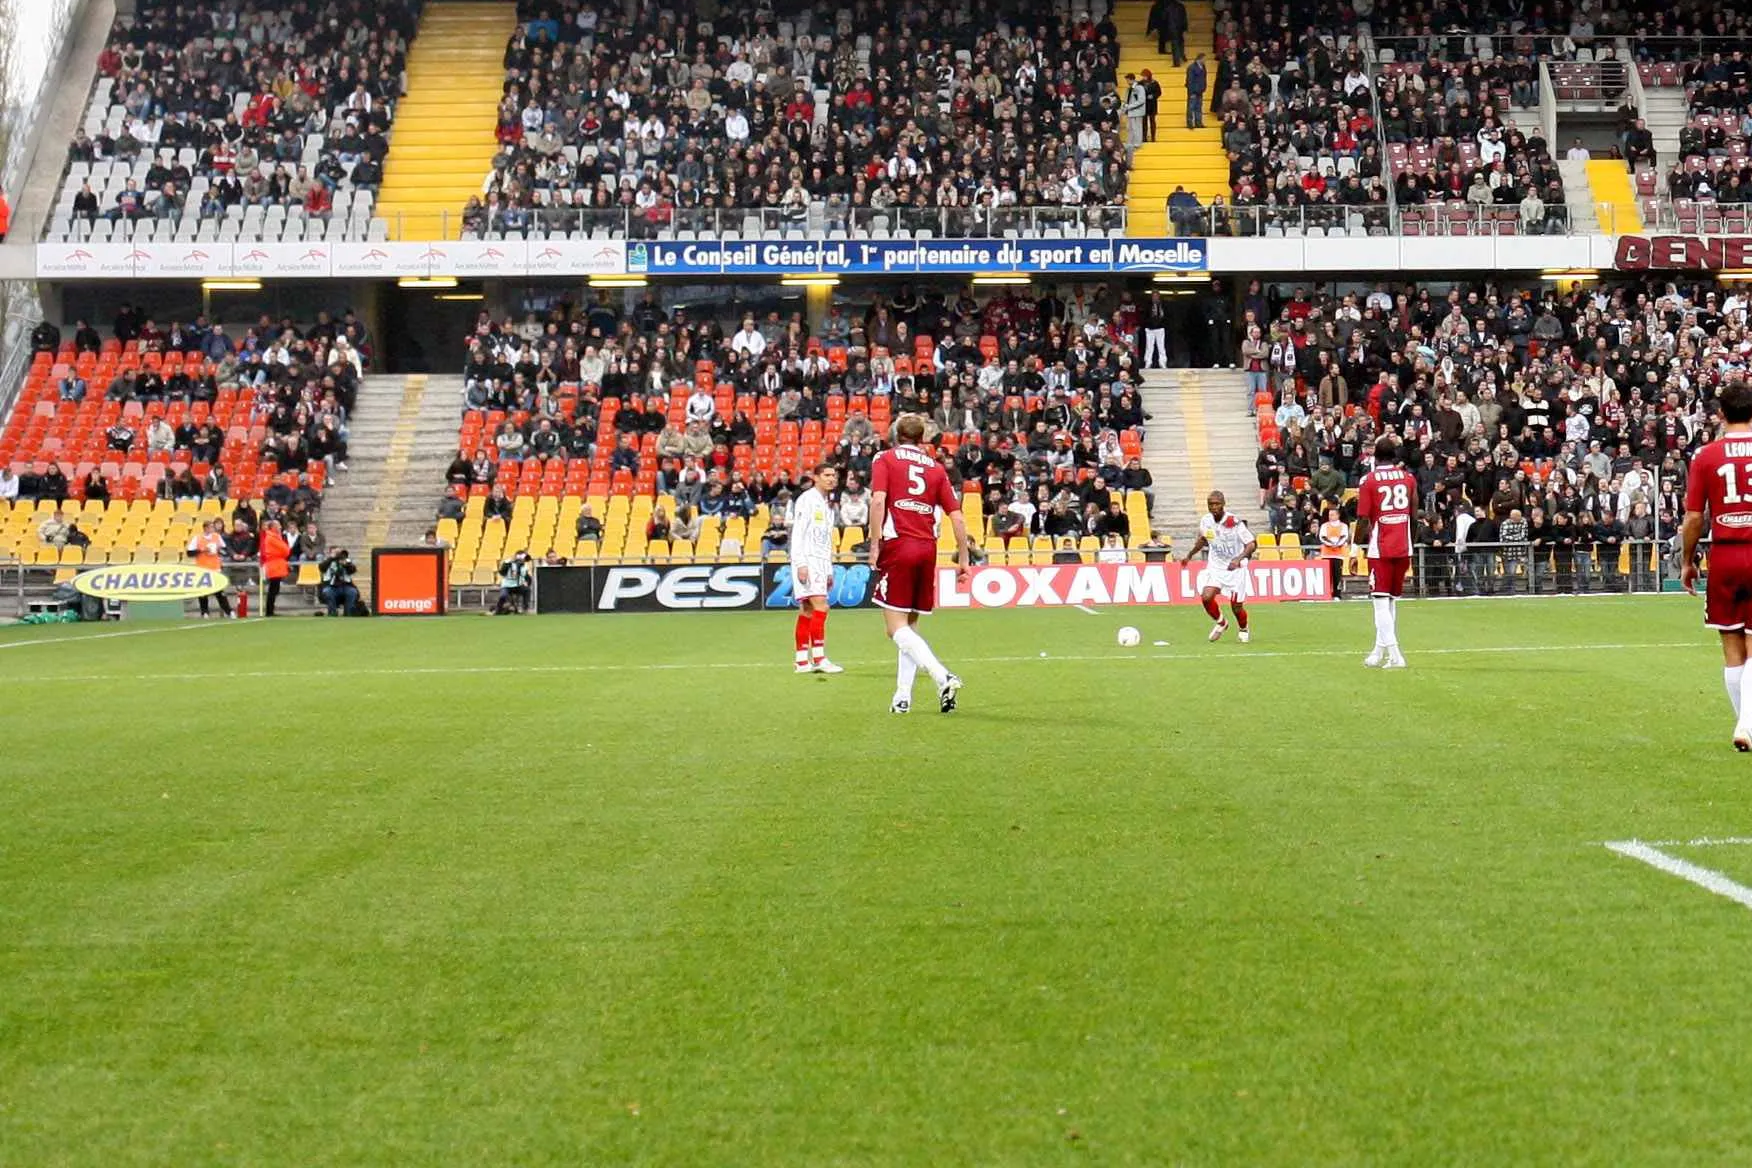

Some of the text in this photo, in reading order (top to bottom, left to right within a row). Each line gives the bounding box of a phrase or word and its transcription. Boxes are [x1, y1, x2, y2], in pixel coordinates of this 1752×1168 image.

[654, 242, 1202, 270] Le Conseil Général, 1er partenaire du sport en Moselle
[908, 464, 926, 496] 5
[1378, 484, 1409, 511] 28
[90, 570, 214, 593] CHAUSSEA
[597, 564, 871, 610] PES 208
[939, 565, 1170, 607] LOXAM
[384, 599, 433, 613] orange
